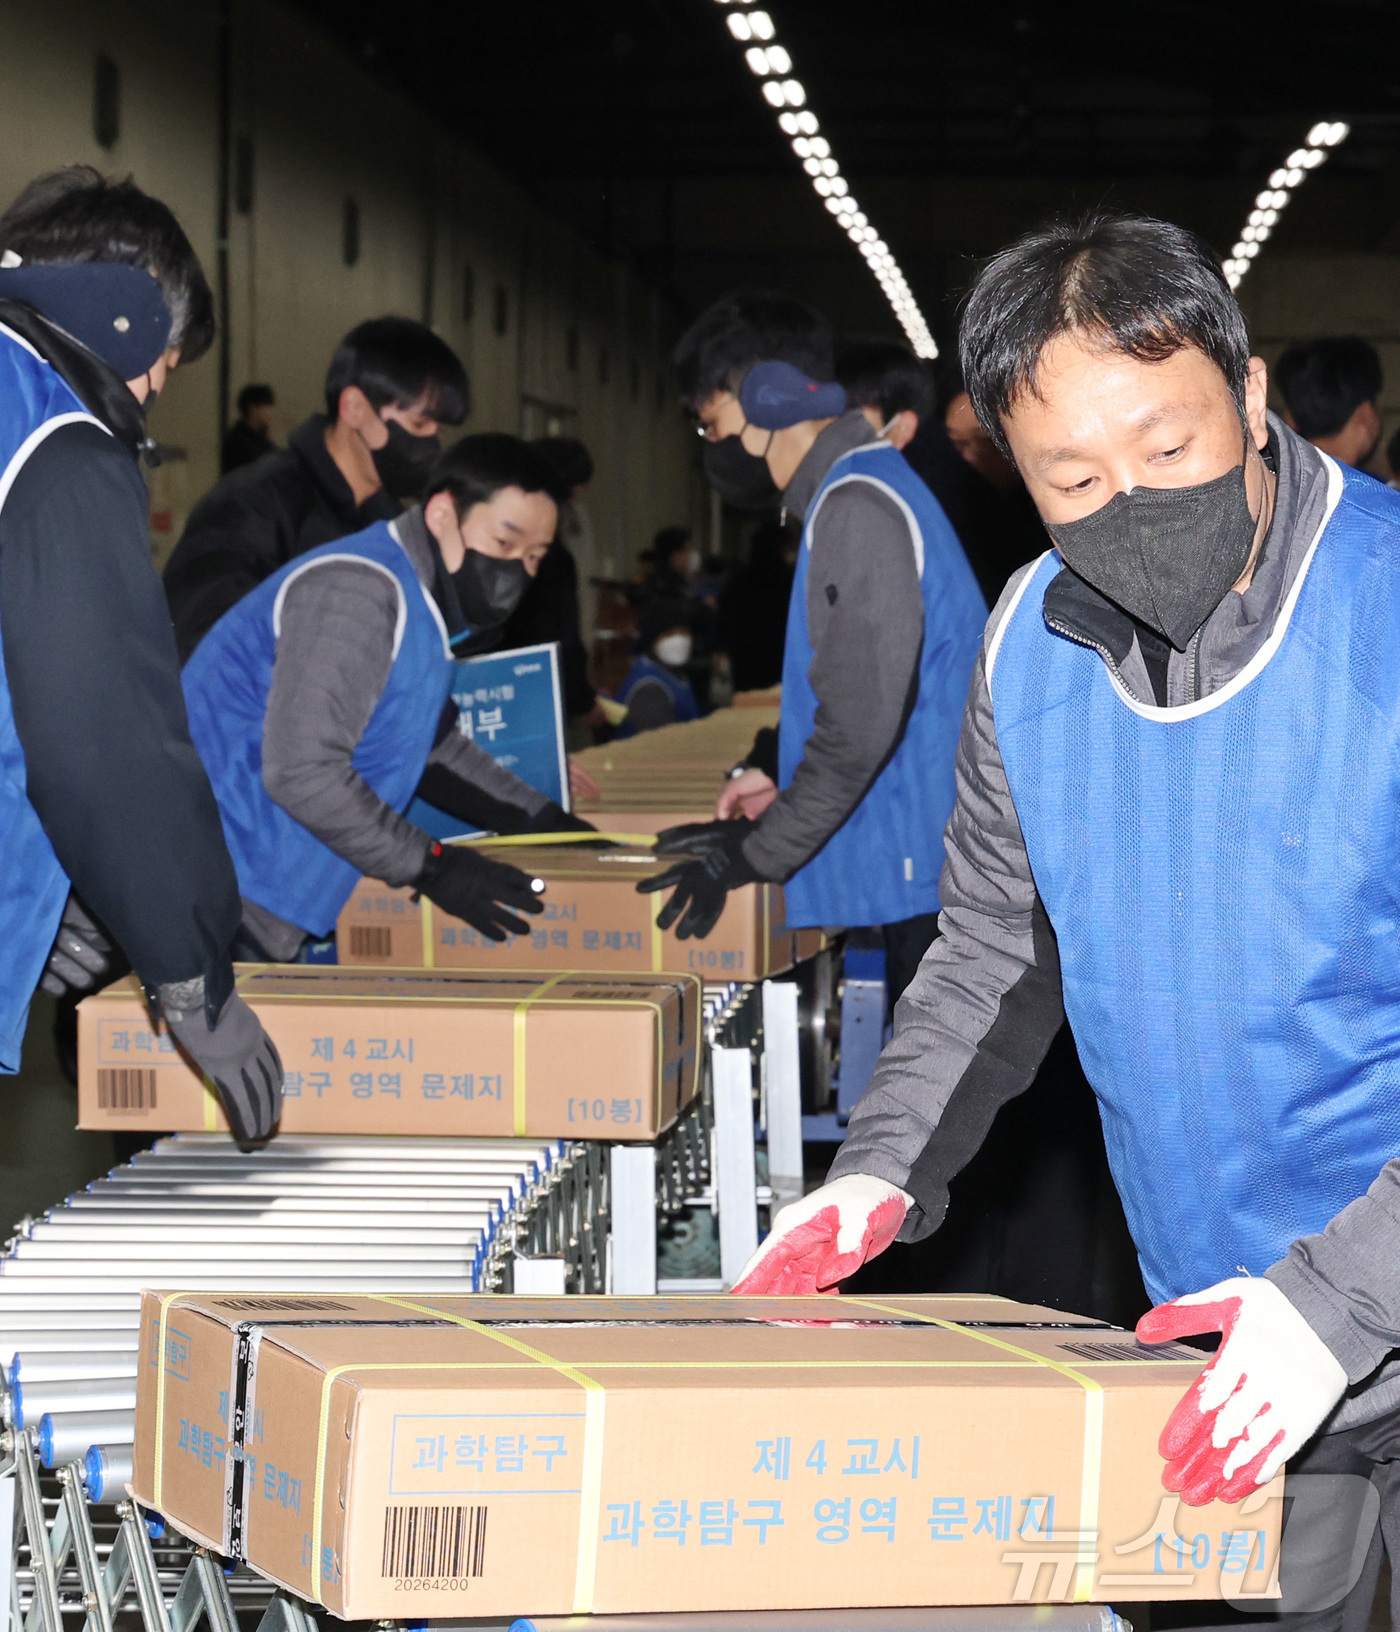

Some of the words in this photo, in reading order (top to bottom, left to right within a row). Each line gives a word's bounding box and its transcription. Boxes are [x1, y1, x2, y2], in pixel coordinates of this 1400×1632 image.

[582, 930, 642, 951] 문제지
[310, 1036, 334, 1062] 제
[343, 1038, 356, 1058] 4
[365, 1038, 414, 1063] 교시
[350, 1072, 401, 1099] 영역
[421, 1073, 502, 1101] 문제지
[178, 1418, 226, 1473] 과학탐구
[263, 1462, 302, 1517] 문제지
[411, 1433, 569, 1474] 과학탐구
[752, 1436, 791, 1481] 제
[805, 1439, 828, 1475] 4
[841, 1435, 921, 1480] 교시
[602, 1498, 785, 1547] 과학탐구
[813, 1496, 897, 1544] 영역
[927, 1495, 1056, 1542] 문제지
[394, 1578, 469, 1592] 20264200
